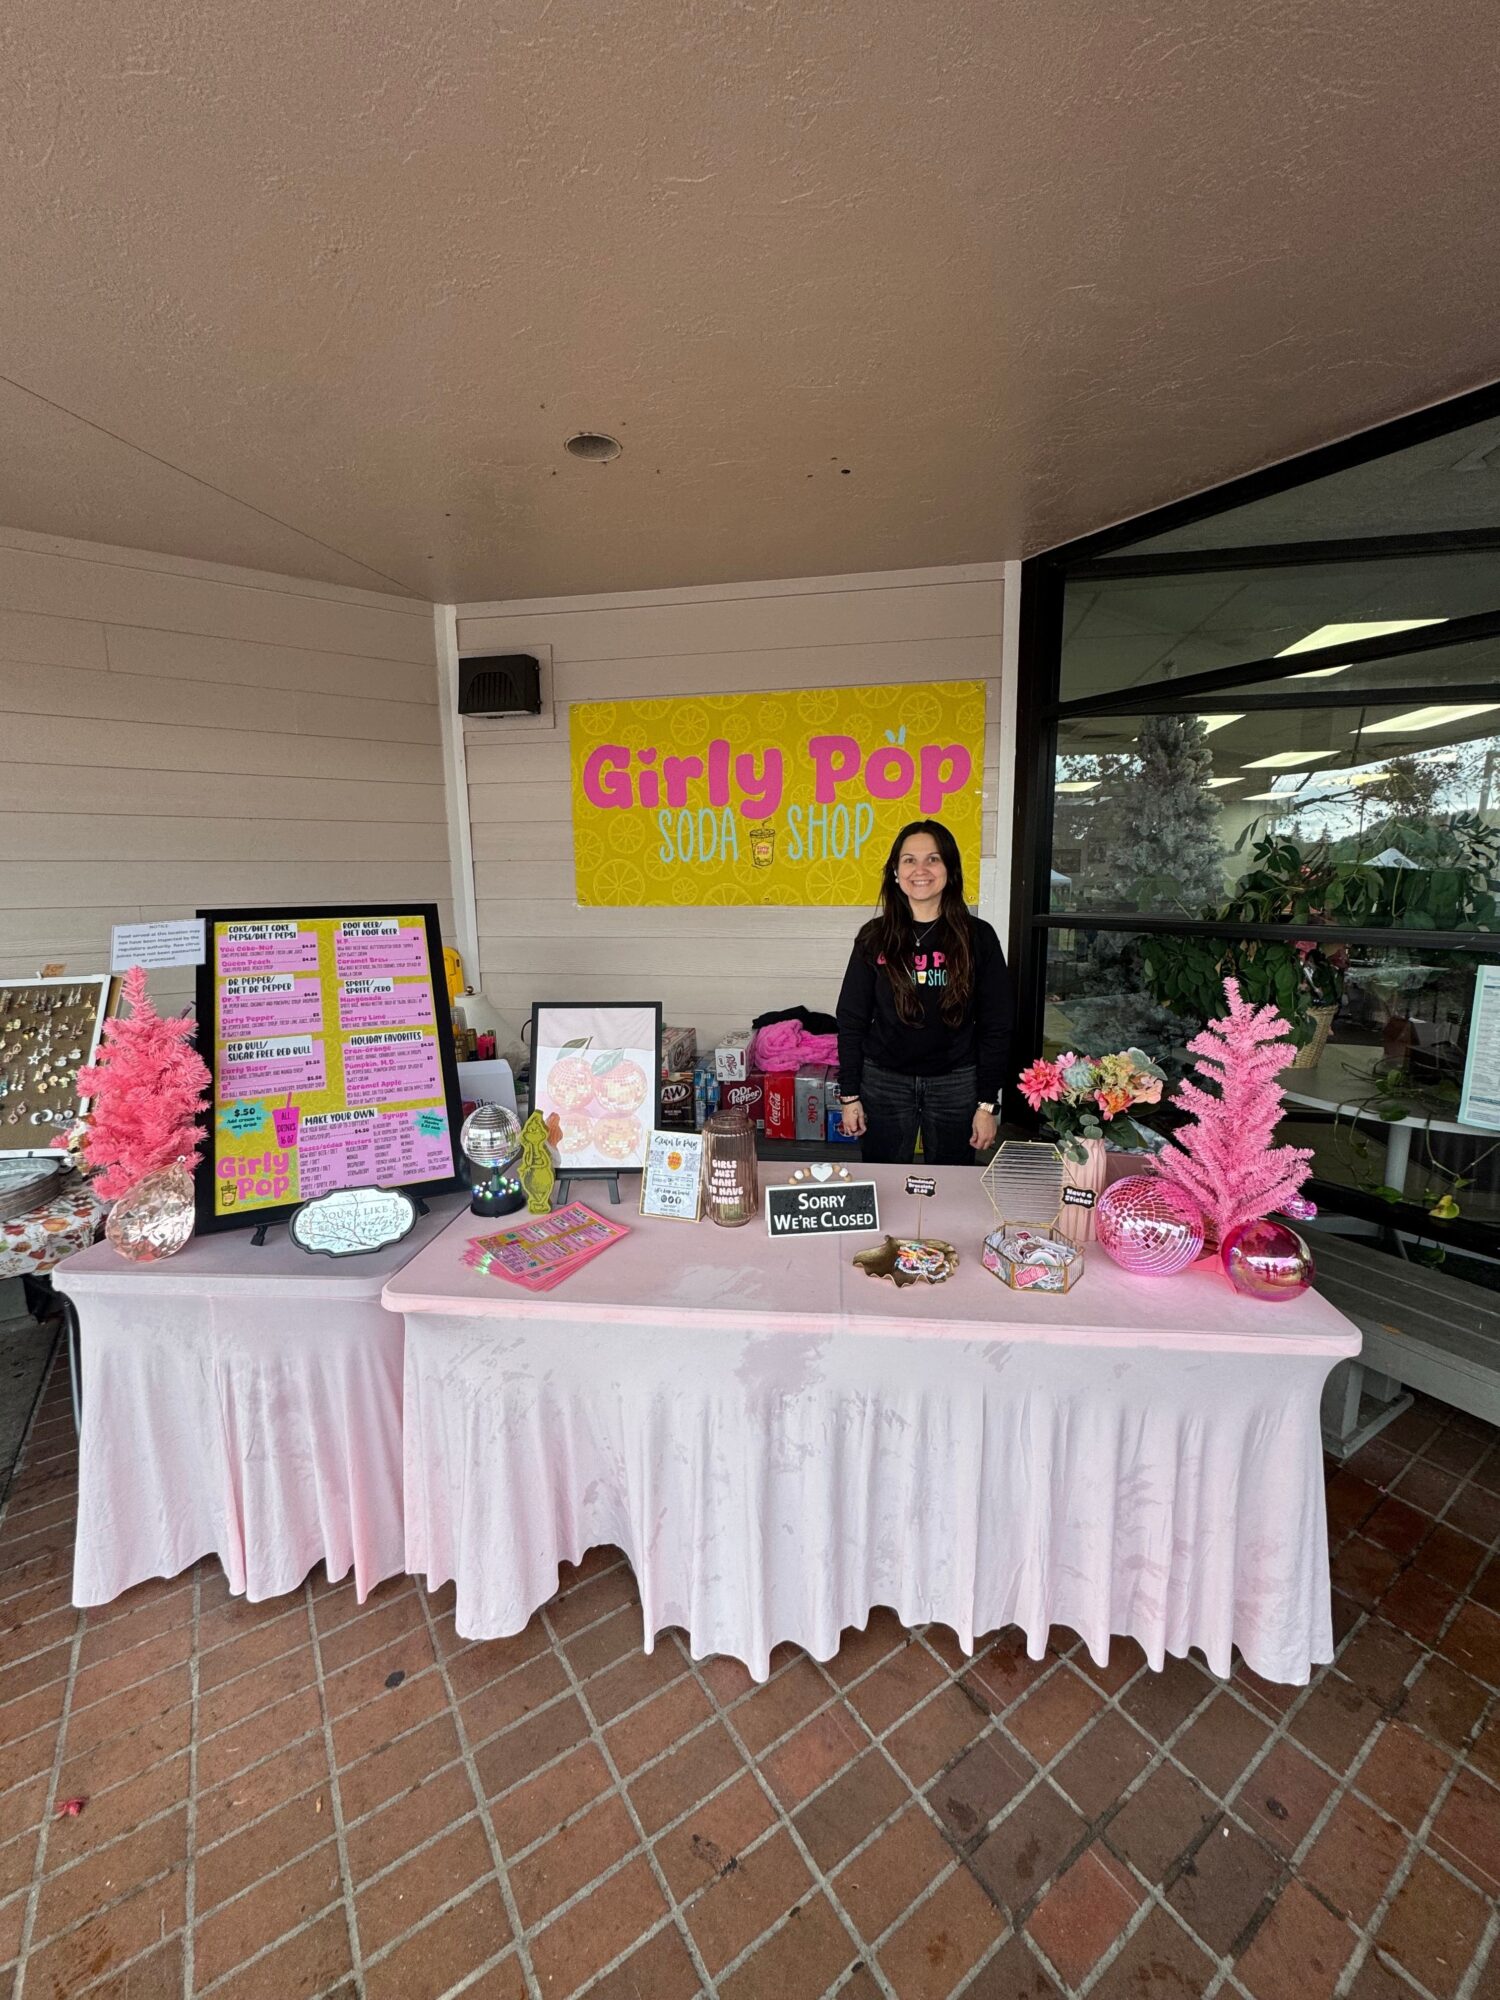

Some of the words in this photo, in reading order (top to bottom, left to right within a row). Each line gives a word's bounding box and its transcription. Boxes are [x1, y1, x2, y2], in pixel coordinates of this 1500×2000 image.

[583, 738, 784, 820] Girly
[808, 735, 972, 815] Pop
[658, 807, 739, 863] SODA
[787, 802, 874, 860] SHOP
[229, 924, 269, 934] COKE/DIET
[271, 924, 289, 932] COKE
[362, 928, 379, 936] ROOT
[229, 932, 272, 940] PEPSI/DIET
[242, 976, 275, 985] PEPPER/
[928, 969, 948, 986] SHO
[228, 986, 246, 994] DIET
[262, 983, 292, 992] PEPPER
[346, 980, 374, 988] SPRITE/
[346, 986, 370, 994] SPRITE
[351, 1036, 382, 1046] HOLIDAY
[384, 1032, 422, 1042] FAVORITES
[228, 1043, 242, 1052] RED
[245, 1041, 268, 1050] BULL/
[228, 1052, 254, 1062] SUGAR
[256, 1049, 275, 1059] FREE
[276, 1048, 291, 1056] RED
[293, 1046, 311, 1054] BULL
[222, 1067, 244, 1075] Early
[347, 1082, 379, 1091] Caramel
[381, 1080, 402, 1088] Apple
[740, 1086, 752, 1096] Dr
[730, 1088, 760, 1105] Pepper
[234, 1108, 256, 1118] $.50
[769, 1092, 780, 1126] Coca-Cola
[808, 1095, 819, 1124] Coke
[282, 1112, 290, 1120] ALL
[305, 1114, 328, 1126] MAKE
[330, 1112, 352, 1122] YOUR
[354, 1109, 374, 1118] OWN
[382, 1112, 408, 1120] Syrups
[277, 1123, 296, 1132] DRINKS
[676, 1138, 682, 1147] to
[216, 1152, 289, 1179] Girly
[712, 1159, 737, 1168] GIRLS
[714, 1170, 736, 1178] JUST
[711, 1176, 736, 1187] WANT
[236, 1176, 289, 1200] Pop
[708, 1186, 718, 1194] TO
[719, 1186, 744, 1196] HAVE
[1066, 1188, 1086, 1198] Have
[712, 1196, 740, 1204] FUNDS
[1064, 1194, 1092, 1204] Sticker
[364, 1206, 389, 1216] LIKE
